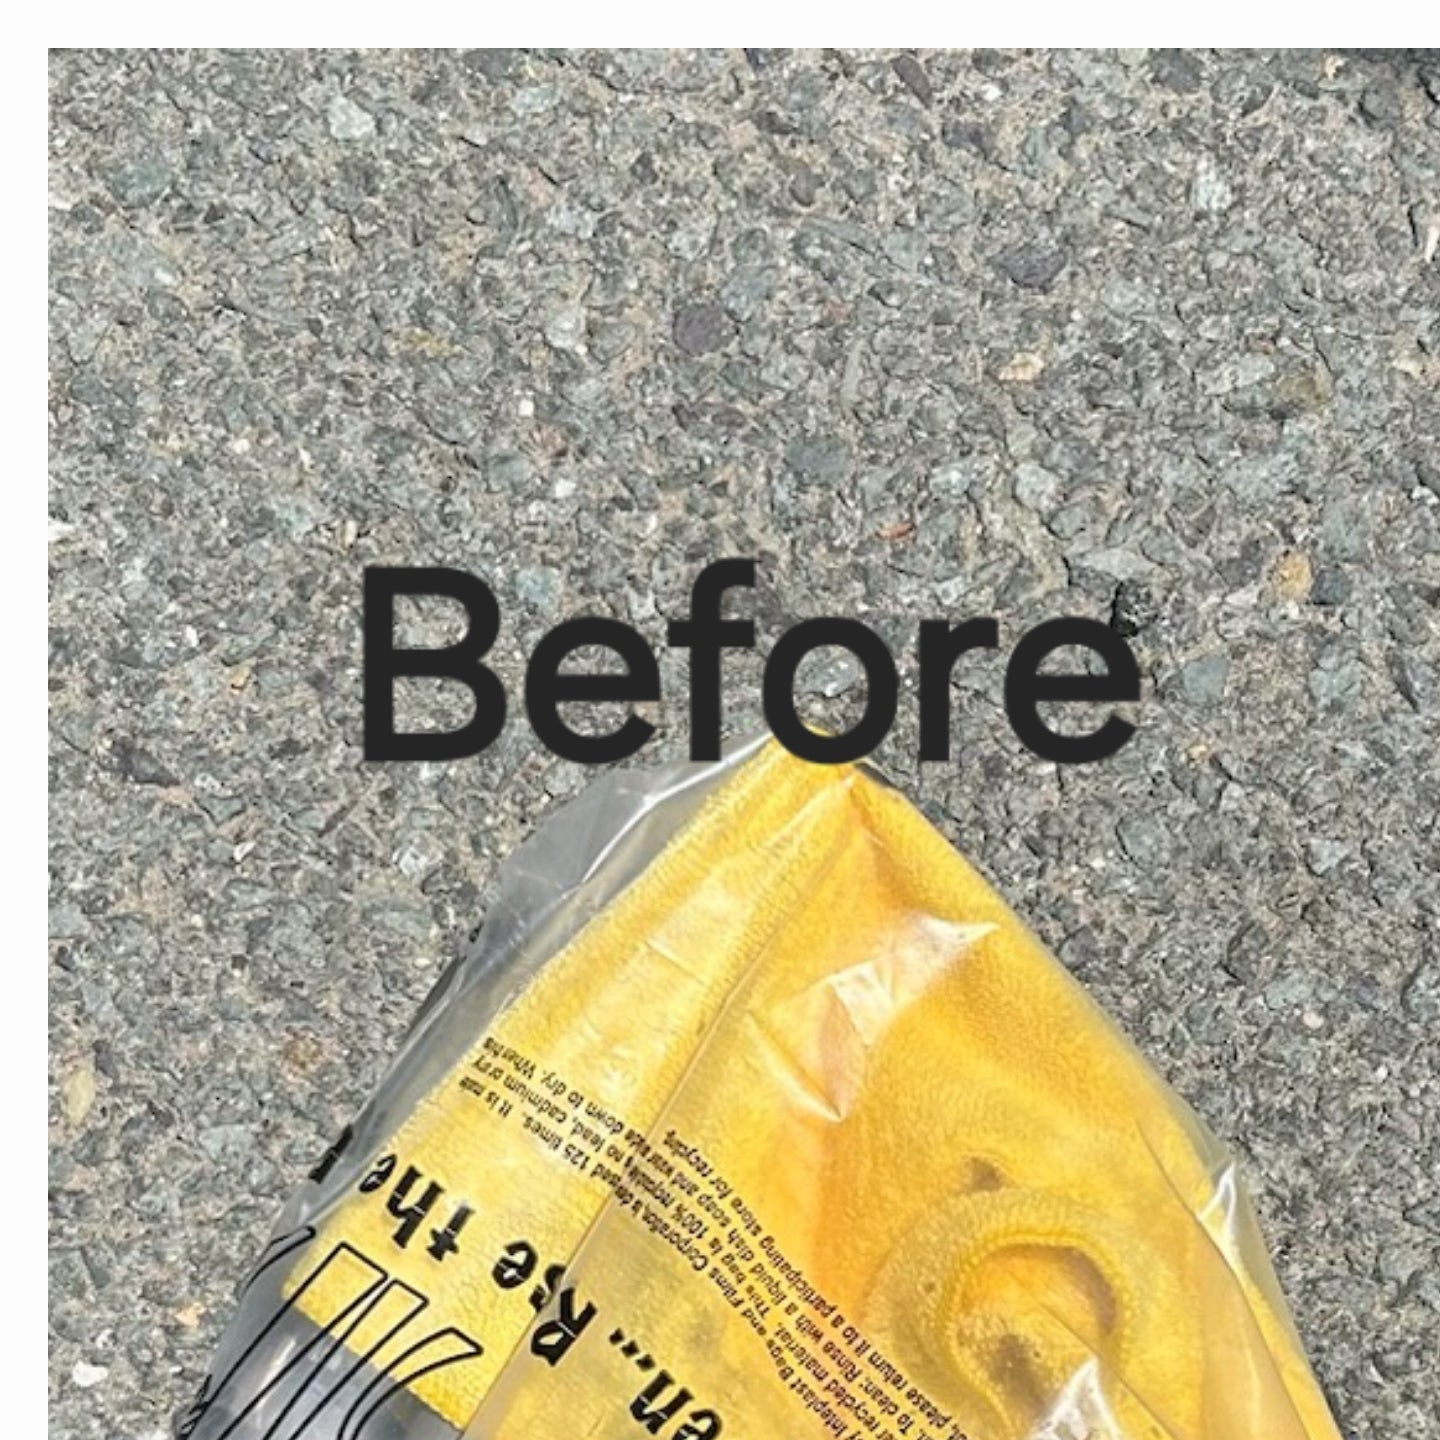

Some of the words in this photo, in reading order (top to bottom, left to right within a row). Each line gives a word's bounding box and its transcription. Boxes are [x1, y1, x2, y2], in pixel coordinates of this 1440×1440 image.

[484, 1091, 499, 1106] is
[500, 1072, 567, 1128] cadmium
[536, 1067, 568, 1098] dry.
[565, 1090, 583, 1108] to
[516, 1111, 563, 1151] times.
[566, 1117, 605, 1151] lead,
[581, 1100, 624, 1137] down
[560, 1142, 590, 1169] 125
[705, 1175, 732, 1201] for
[358, 1153, 475, 1282] the
[693, 1191, 734, 1229] soap
[724, 1196, 765, 1238] store
[705, 1237, 724, 1256] is
[722, 1228, 758, 1263] dish
[715, 1251, 750, 1284] bag
[746, 1261, 790, 1306] liquid
[753, 1234, 838, 1321] participating
[704, 1267, 745, 1308] Films
[739, 1284, 773, 1318] This
[740, 1306, 769, 1336] and
[783, 1301, 798, 1316] a
[829, 1314, 845, 1329] a
[792, 1313, 824, 1345] with
[838, 1325, 859, 1346] to
[760, 1338, 799, 1377] Bags
[770, 1321, 829, 1382] material.
[818, 1340, 861, 1383] Rinse
[853, 1340, 870, 1357] it
[865, 1350, 908, 1393] return
[787, 1376, 848, 1437] Inteplast
[823, 1376, 881, 1434] recycled
[903, 1383, 951, 1431] please
[893, 1412, 915, 1435] To
